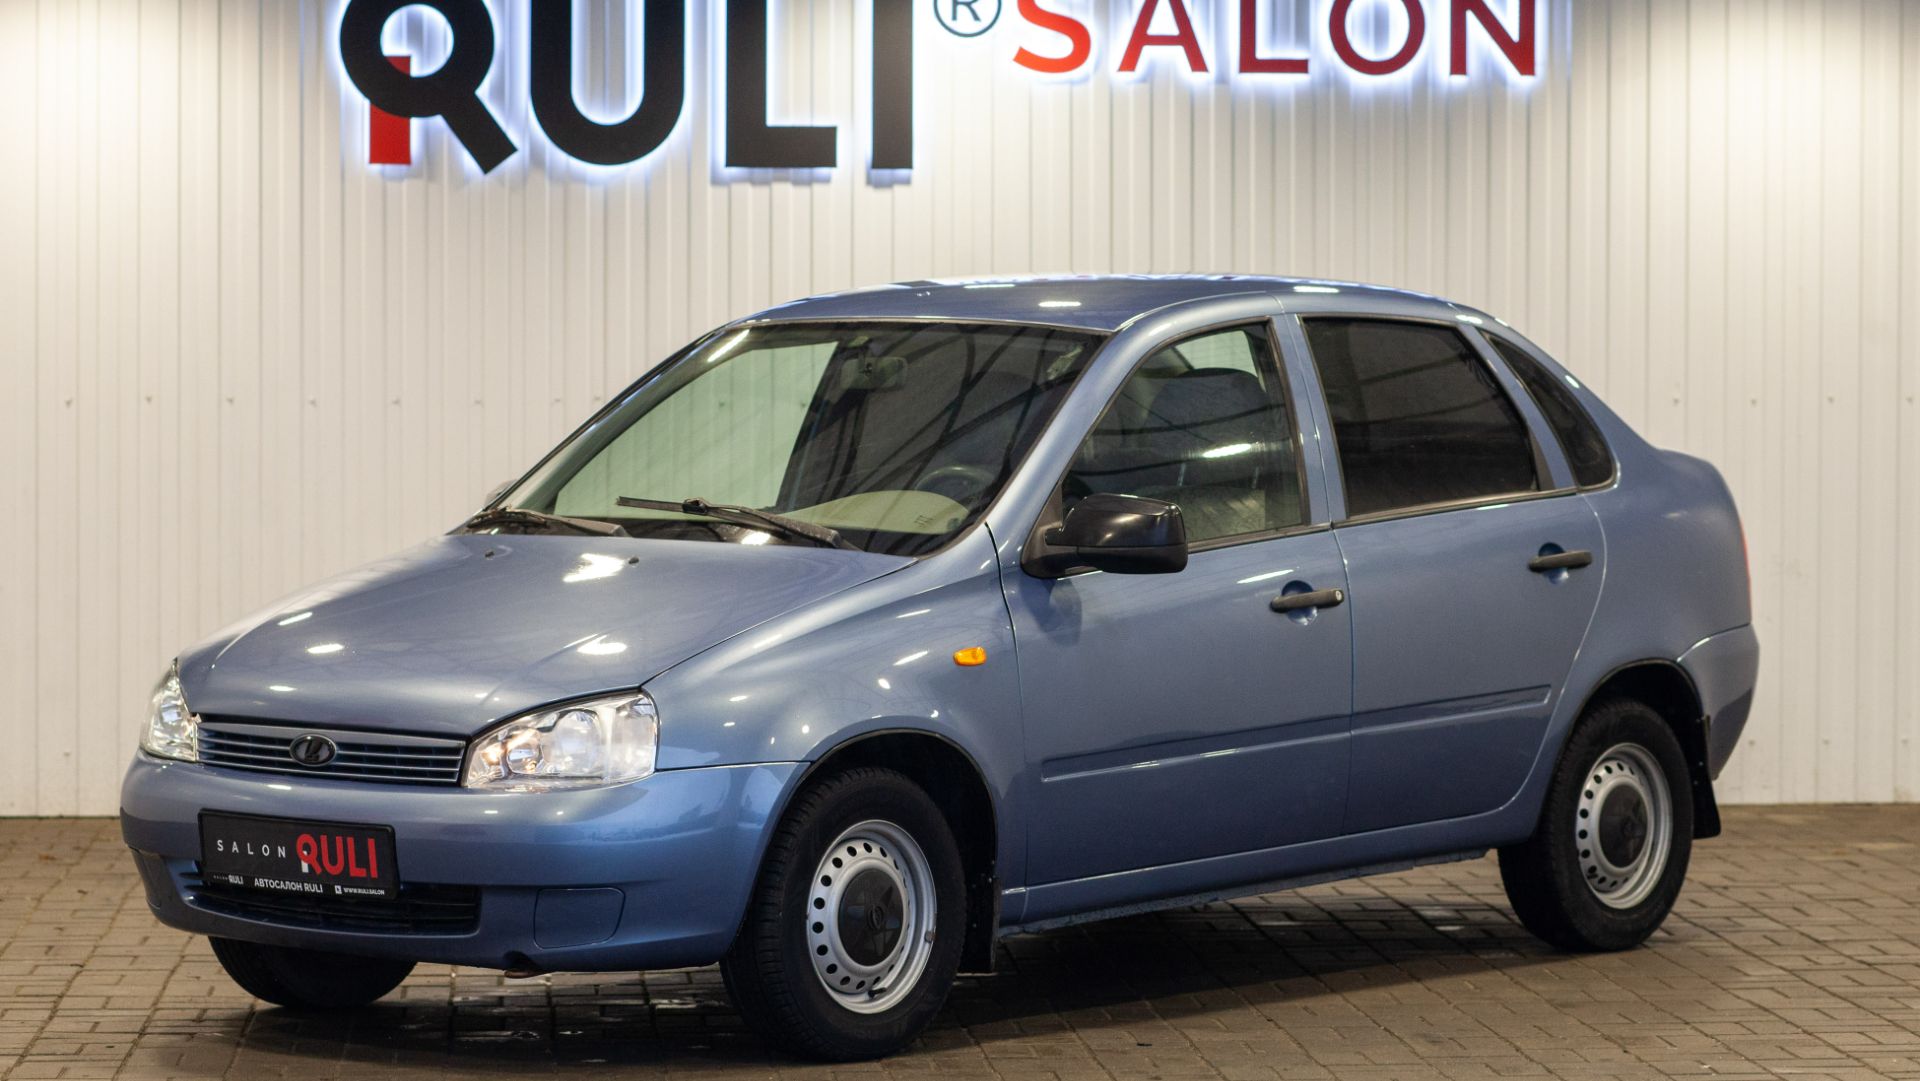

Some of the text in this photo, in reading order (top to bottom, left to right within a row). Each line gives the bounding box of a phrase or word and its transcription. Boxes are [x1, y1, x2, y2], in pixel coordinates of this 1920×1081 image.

[1013, 0, 1536, 76] SALON
[340, 0, 913, 174] RULI
[217, 834, 378, 878] SALON RULI
[254, 878, 323, 893] АВТОСАЛОН RULI
